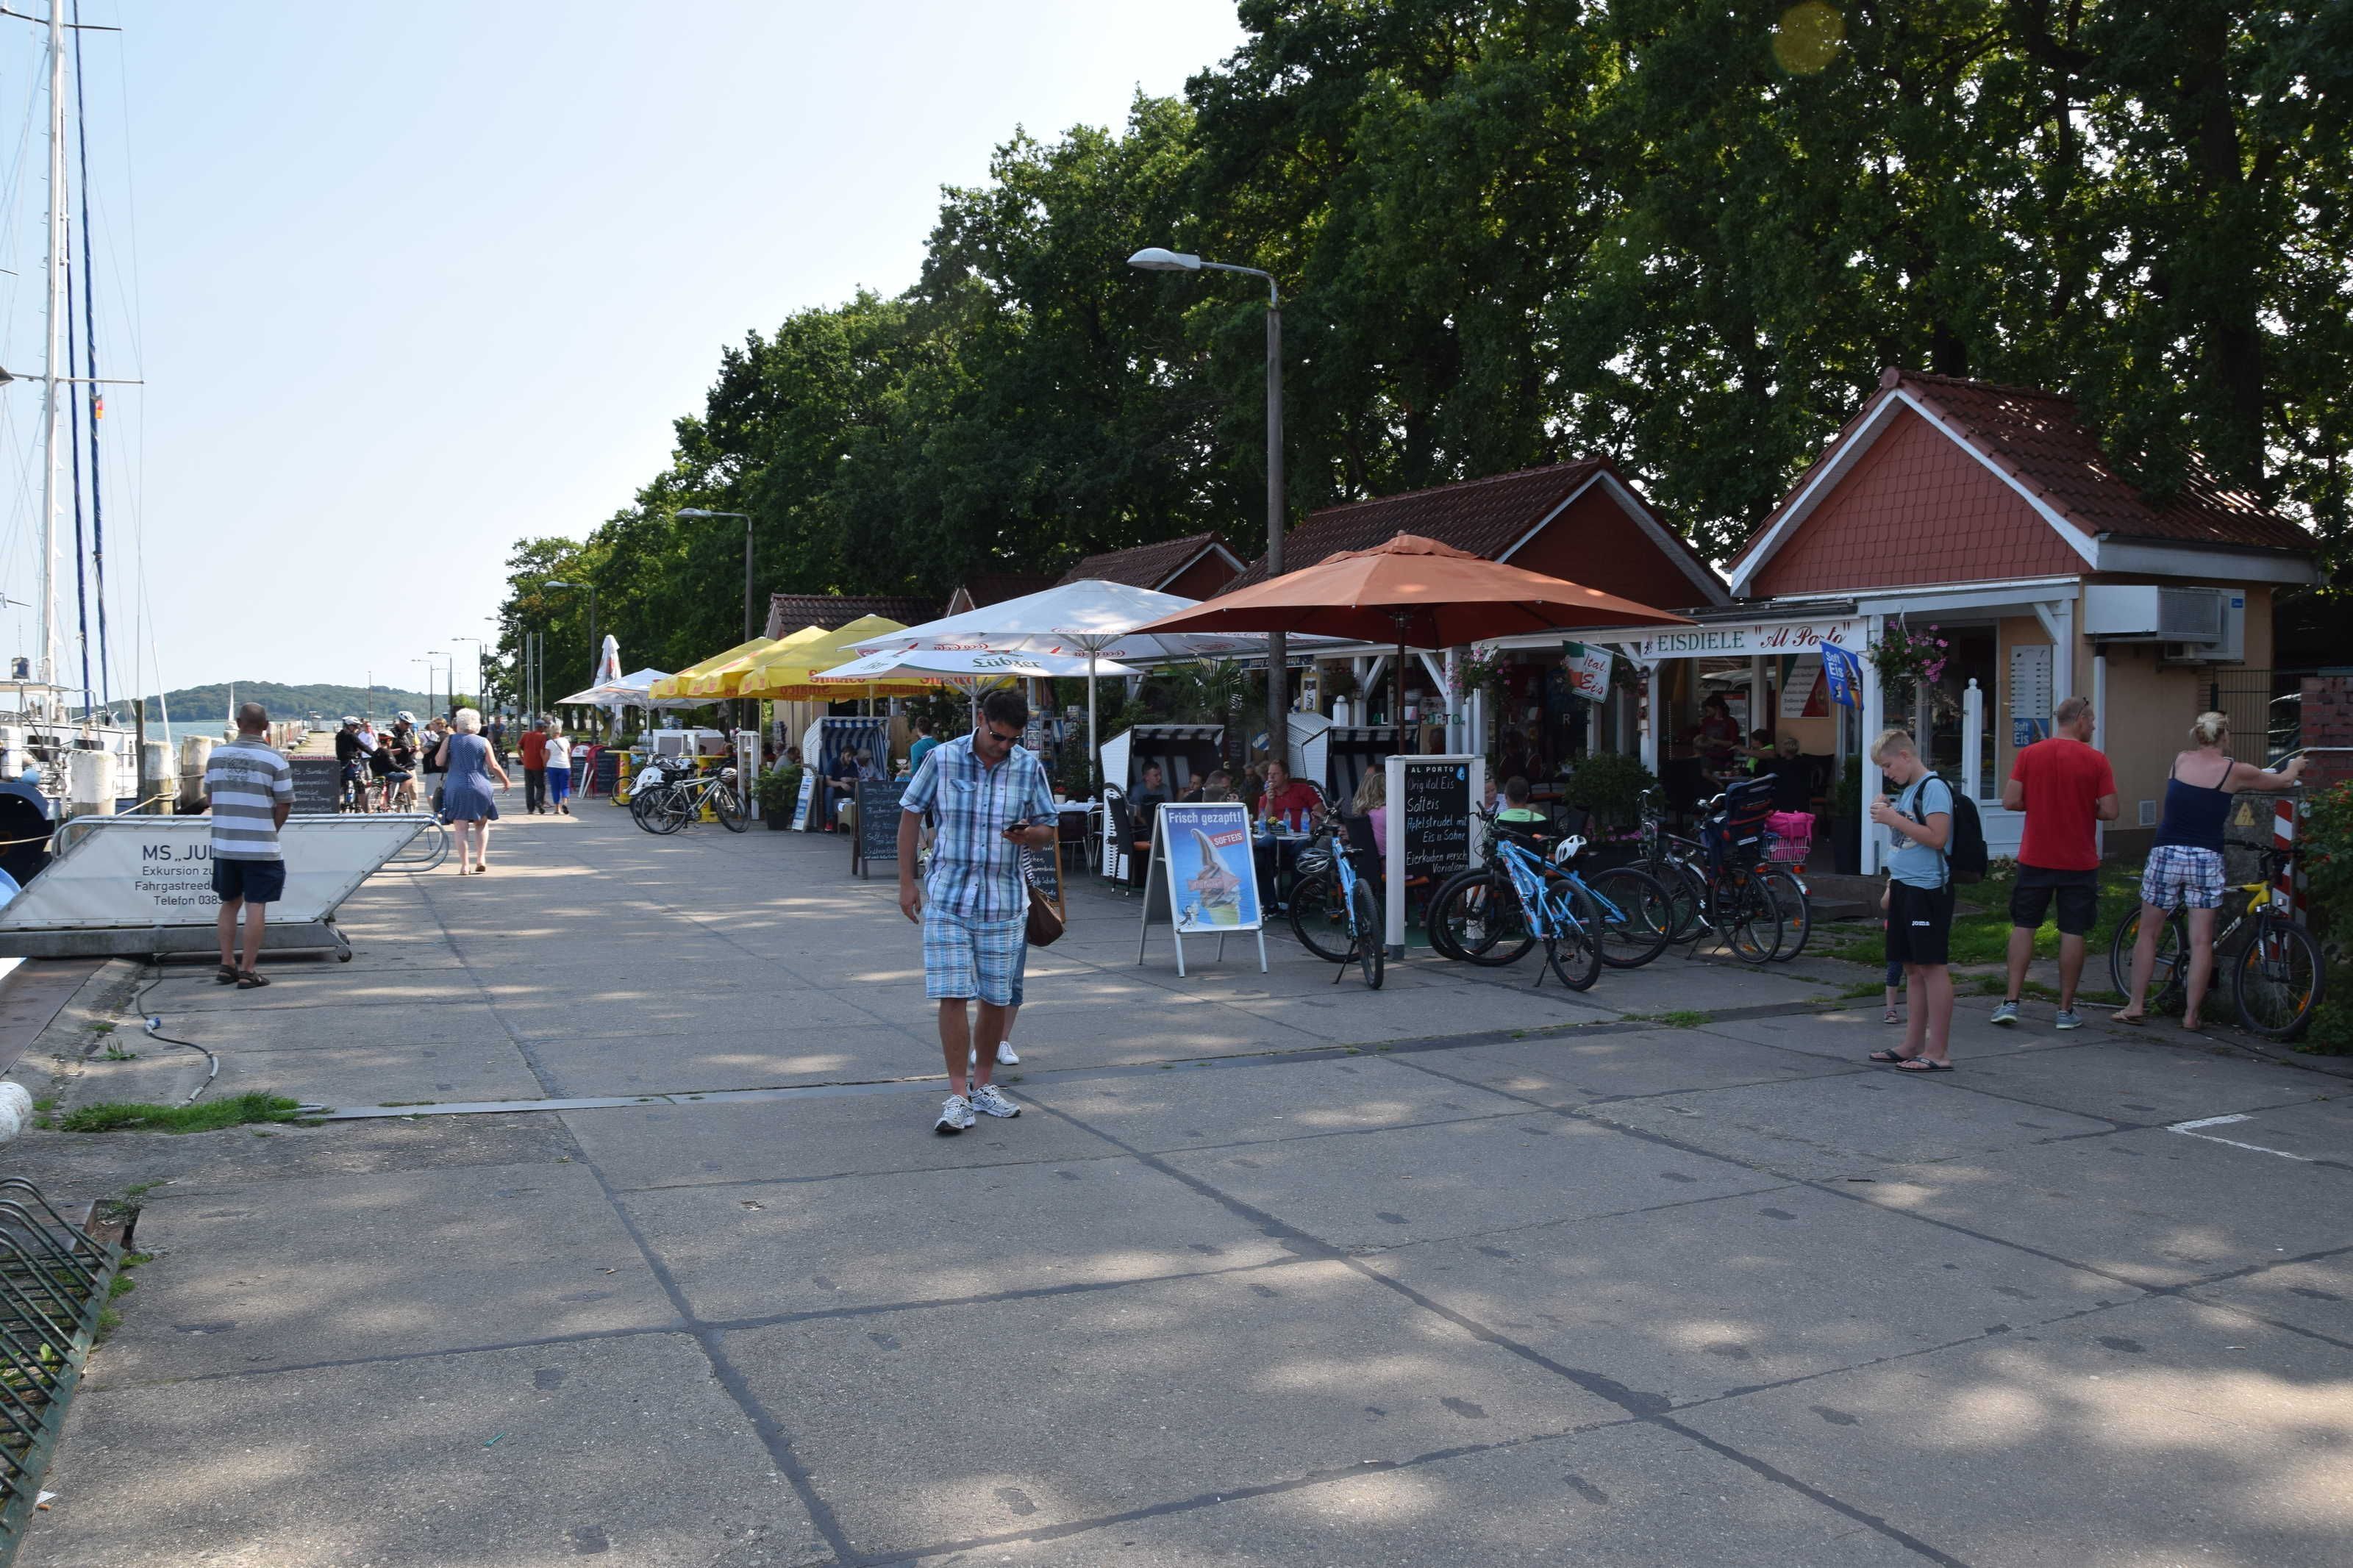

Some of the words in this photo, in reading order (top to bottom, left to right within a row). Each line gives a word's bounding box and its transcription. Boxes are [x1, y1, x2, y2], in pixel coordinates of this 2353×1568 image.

[1657, 630, 1745, 651] EISDIELE
[972, 656, 1042, 667] Lübzer
[1583, 654, 1607, 673] Ital.
[1828, 662, 1844, 679] Eis
[1580, 673, 1603, 695] Eis
[1371, 712, 1388, 725] AL
[2014, 723, 2029, 732] Soft
[2014, 732, 2029, 745] Eis
[1440, 776, 1454, 790] Eis
[1407, 796, 1440, 812] Softeis
[1168, 812, 1198, 823] Frisch
[1201, 811, 1242, 826] gezapft!
[1407, 814, 1453, 834] Apfelstrudel
[1457, 816, 1468, 826] mit
[1214, 832, 1243, 846] SOFTEIS
[1423, 831, 1435, 842] Eis
[143, 845, 171, 861] MS
[1406, 848, 1443, 866] Eierkuchen
[143, 866, 199, 876] Exkursion
[135, 881, 210, 893] Fahrgastreed
[154, 895, 195, 905] Telefon
